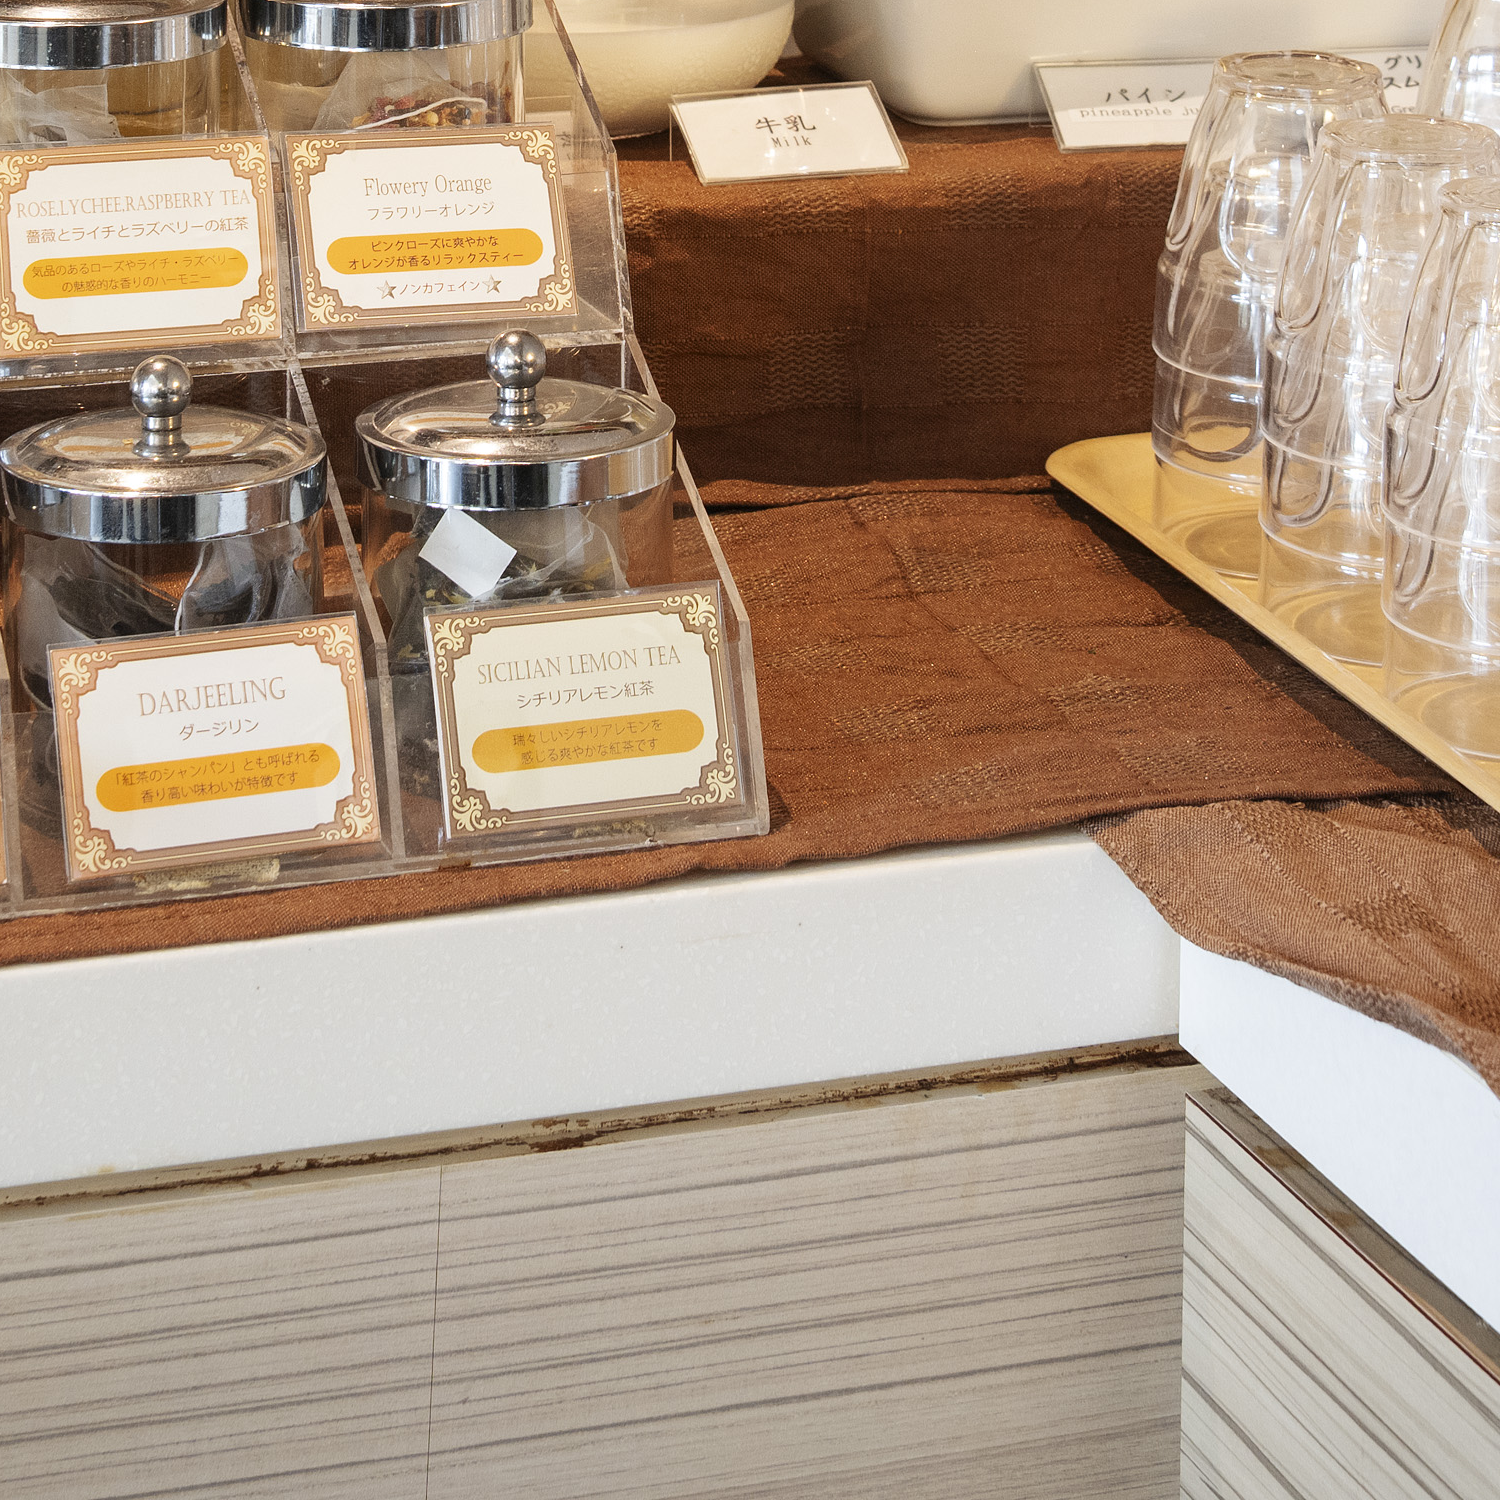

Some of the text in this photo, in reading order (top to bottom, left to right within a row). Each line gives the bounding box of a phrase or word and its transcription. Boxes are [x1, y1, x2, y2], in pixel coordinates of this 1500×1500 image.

[1080, 106, 1173, 119] pineapple
[755, 114, 816, 135] 牛乳
[772, 135, 813, 149] Milk
[363, 173, 493, 197] Flowery Orange
[219, 188, 251, 207] TEA
[367, 201, 496, 221] フラワリーオレンジ
[26, 216, 249, 245] 薔薇とライチとラズベリーの紅茶
[371, 235, 499, 253] ピンクローズに爽やかな
[348, 251, 524, 271] オレンジが香るリラックスティー
[62, 273, 212, 293] の魅惑的な香りのハーモニー
[399, 280, 481, 296] ノンカフェイン
[477, 644, 682, 685] SICILIAN LEMON TEA
[137, 676, 288, 717] DARJEELING
[517, 680, 655, 709] シチリアレモン紅茶
[179, 718, 260, 741] ダージリン
[512, 718, 662, 747] 瑞々しいシチリアレモンを
[520, 737, 659, 765] 感じる爽やかな紅茶です
[140, 770, 299, 805] 香り高い味わいが特徴です
